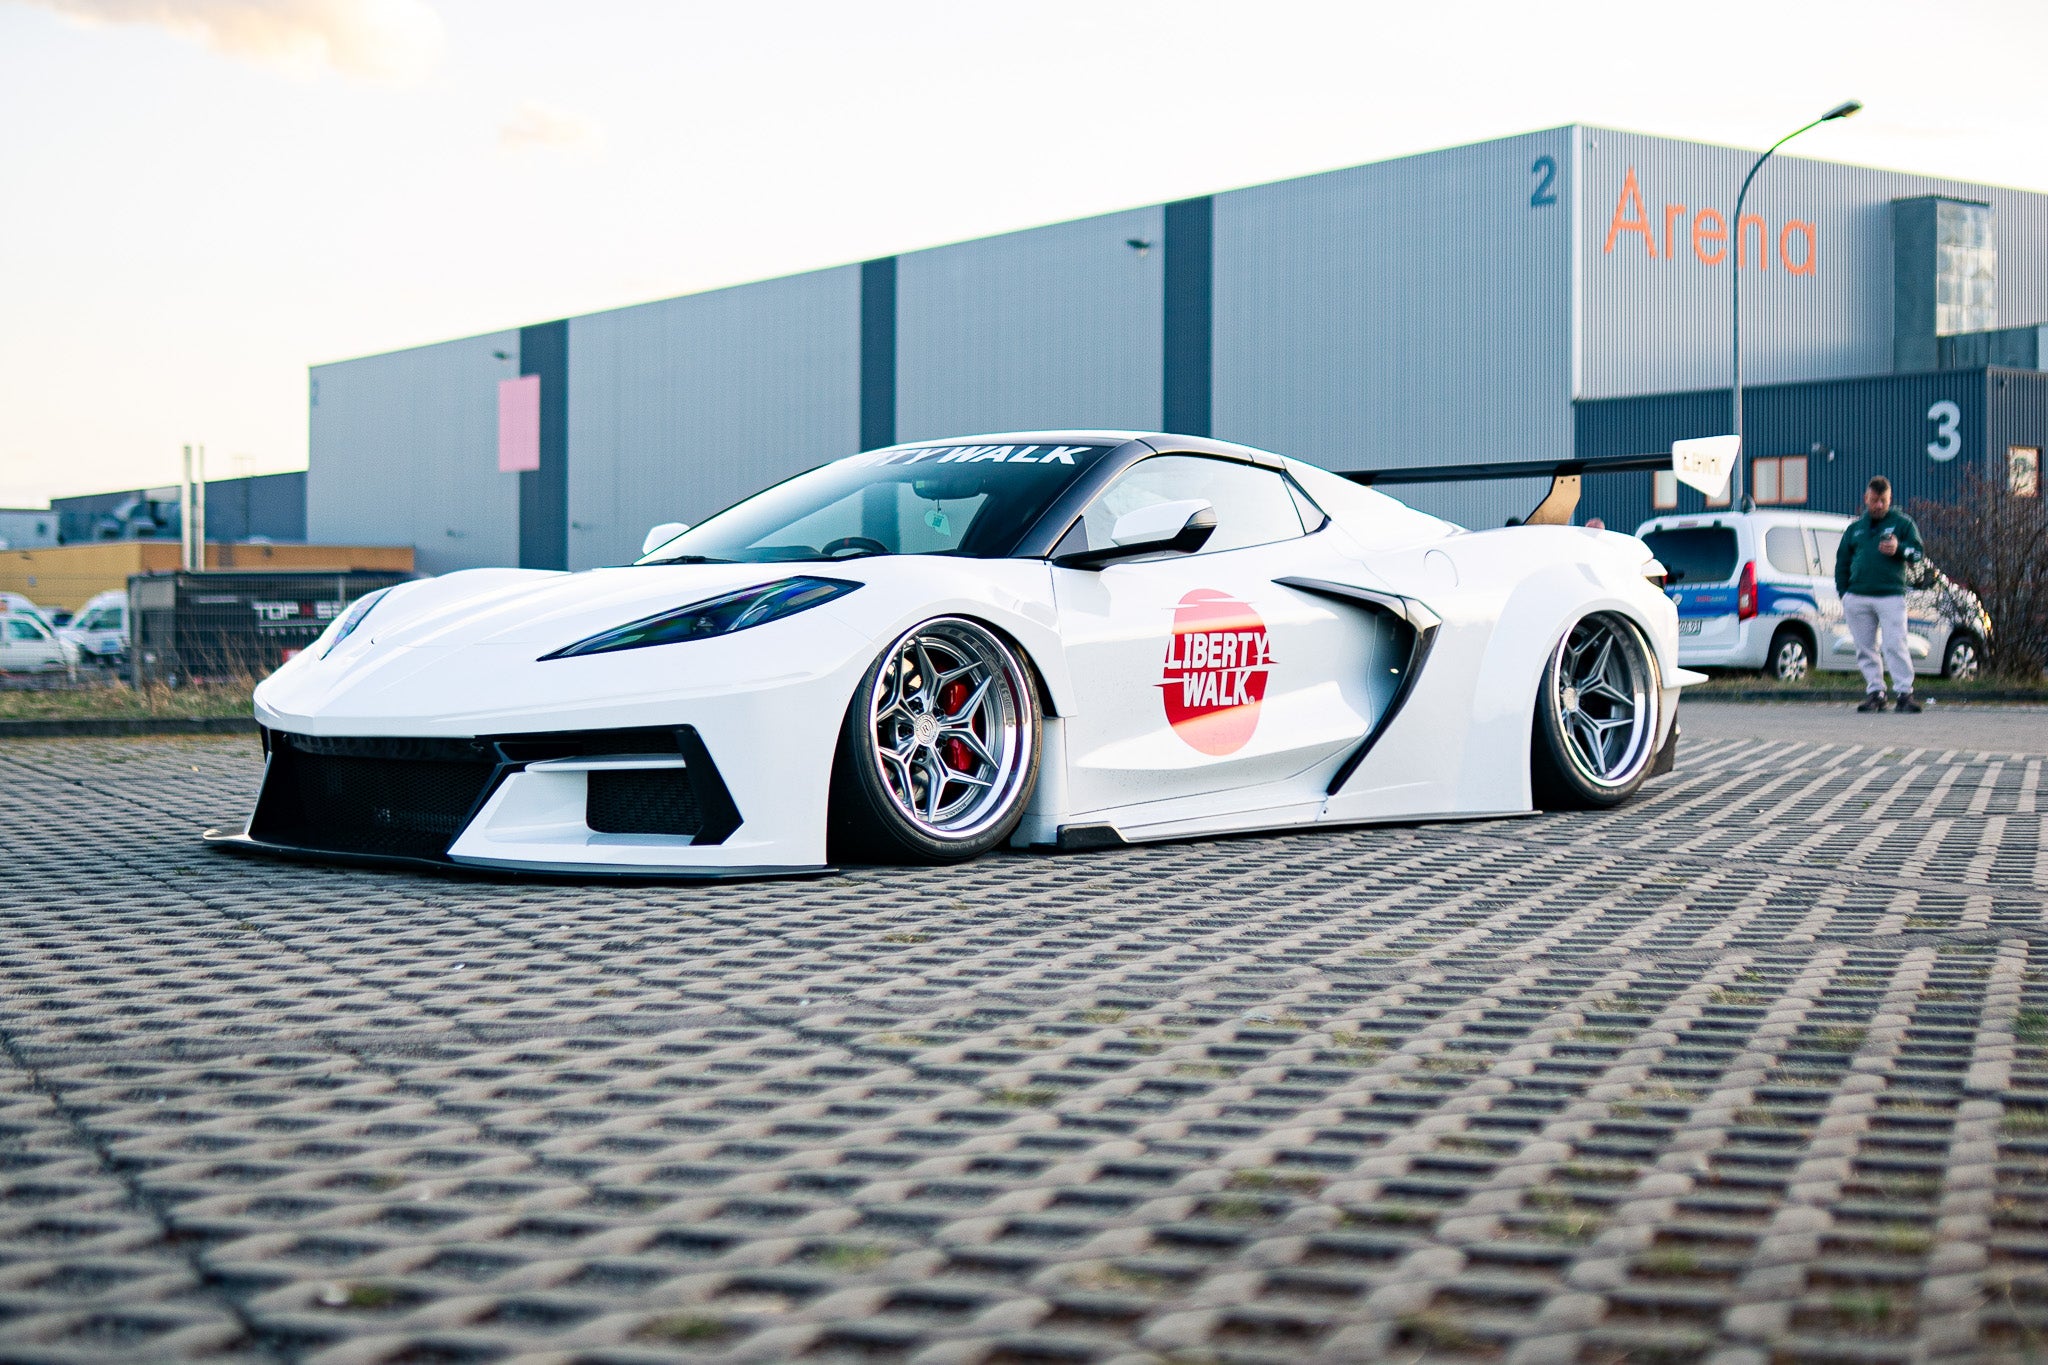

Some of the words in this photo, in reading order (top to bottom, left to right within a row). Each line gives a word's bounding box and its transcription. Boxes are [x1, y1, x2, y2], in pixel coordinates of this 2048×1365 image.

[1530, 155, 1557, 208] 2
[1604, 165, 1817, 276] Arena
[936, 445, 1093, 465] WALK
[1927, 400, 1962, 462] 3
[1164, 632, 1271, 670] LIBERTY
